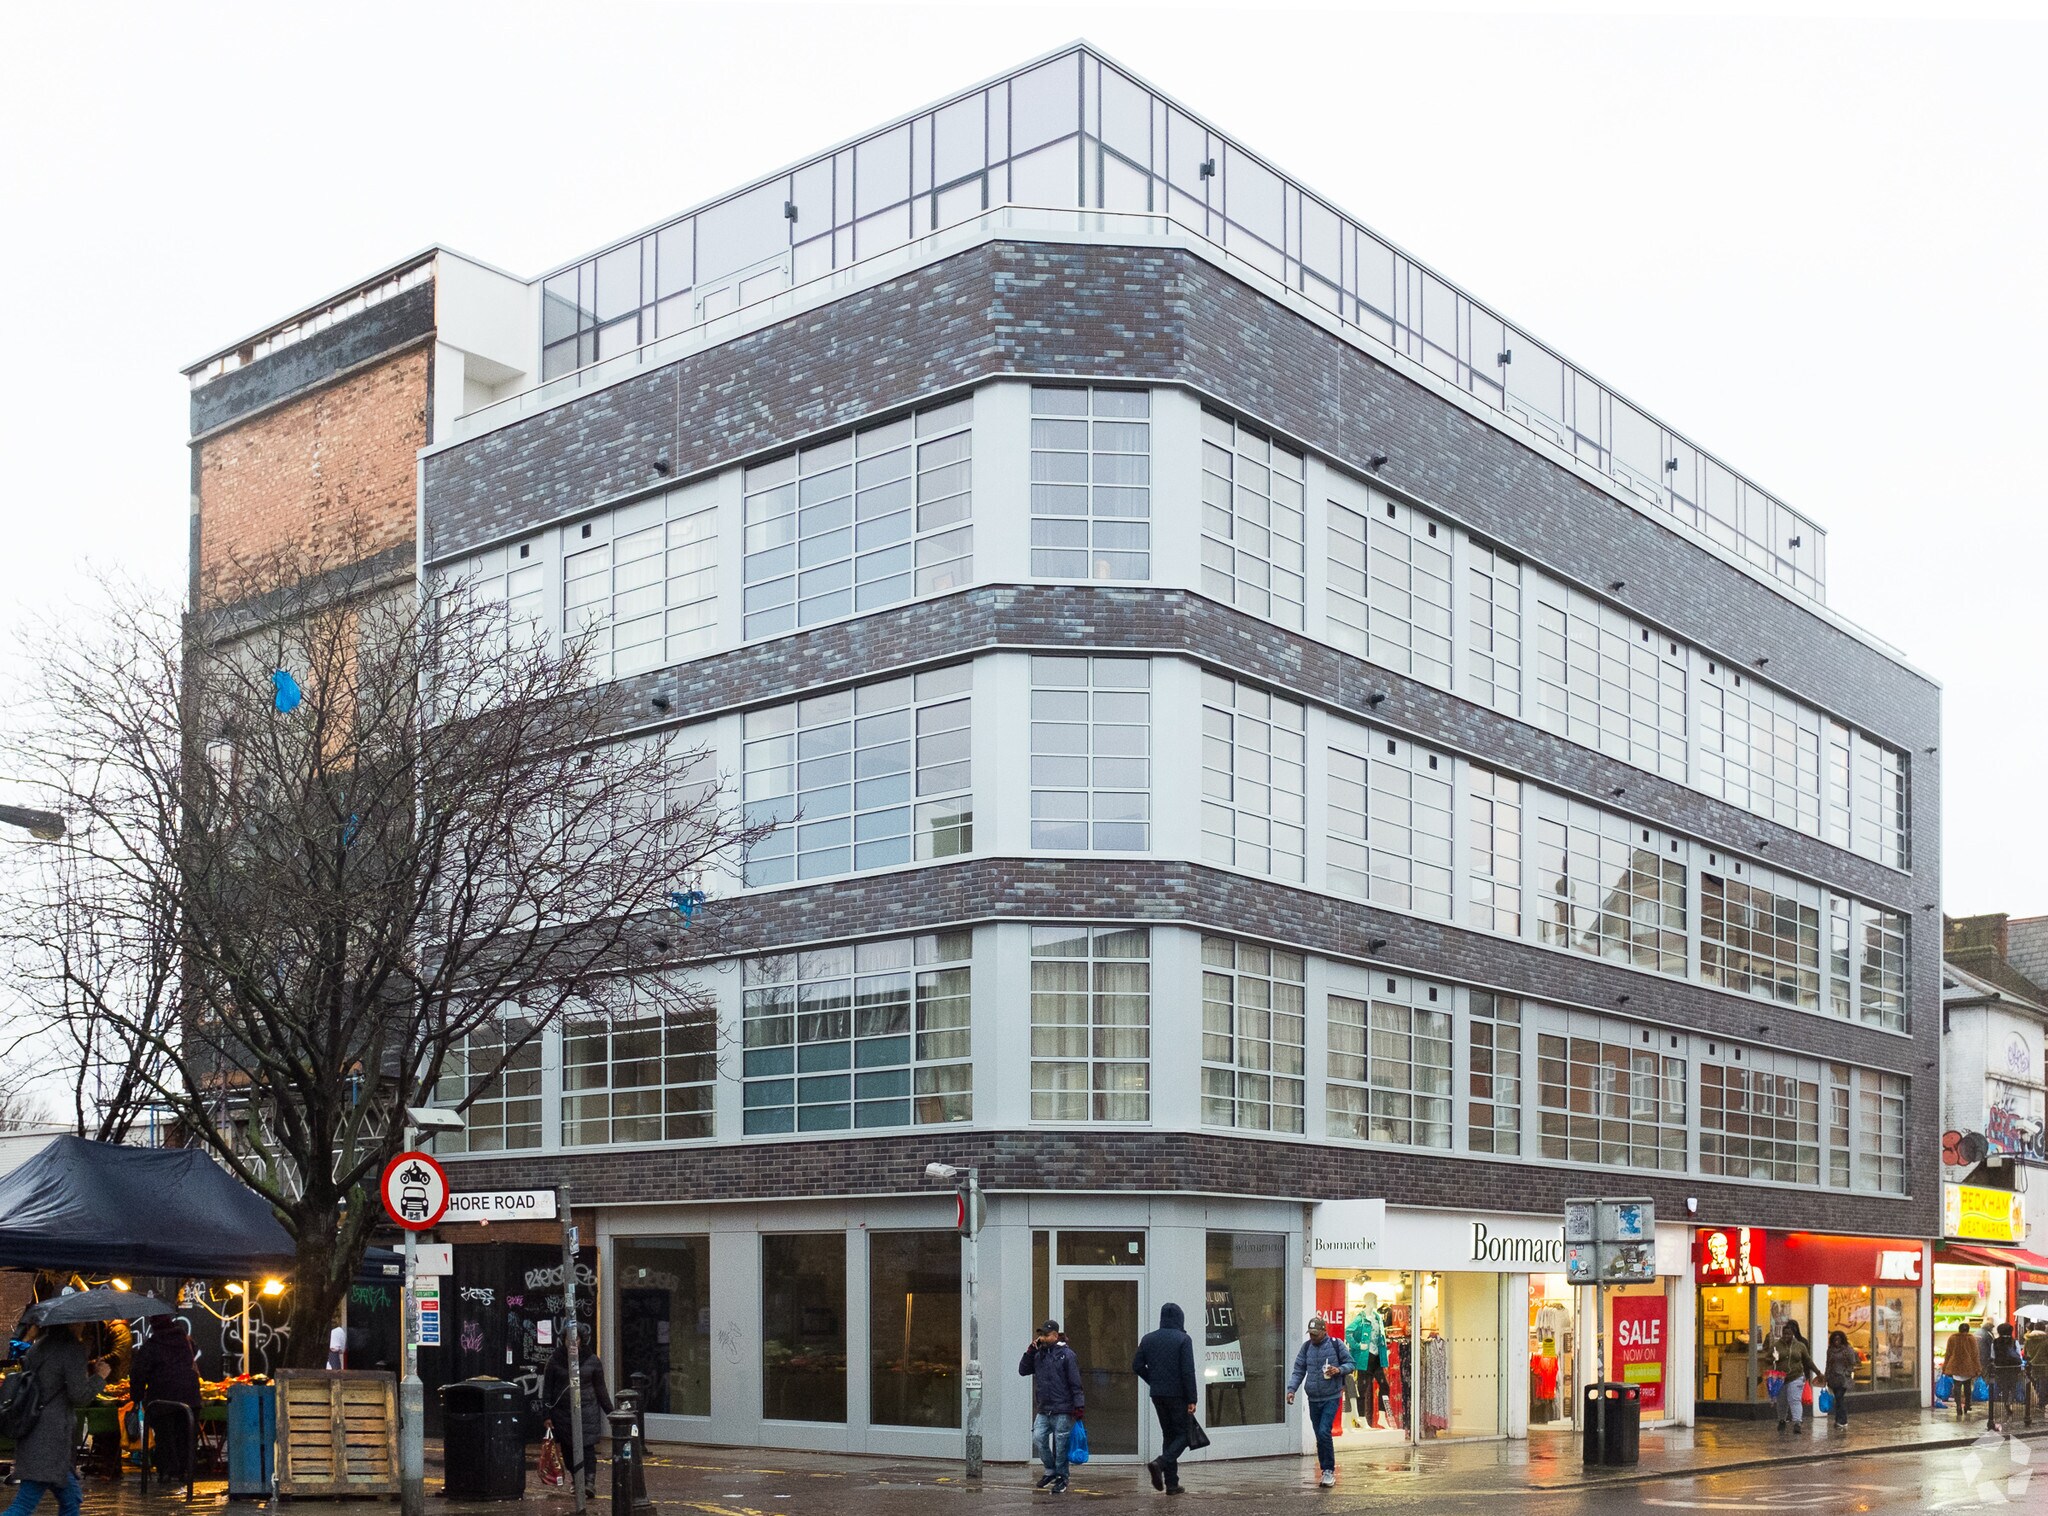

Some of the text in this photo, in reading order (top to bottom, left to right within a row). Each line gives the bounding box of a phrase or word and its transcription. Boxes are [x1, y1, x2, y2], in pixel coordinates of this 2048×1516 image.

[495, 1195, 535, 1209] ROAD
[1961, 1191, 2009, 1212] PECKHAM
[1961, 1220, 2008, 1237] MEAT MARKET
[1214, 1292, 1229, 1303] UNIT
[1211, 1307, 1233, 1327] LET
[1316, 1310, 1343, 1324] SALE
[1619, 1319, 1660, 1346] SALE
[1623, 1348, 1656, 1361] NOW ON
[1223, 1367, 1239, 1377] LEVY
